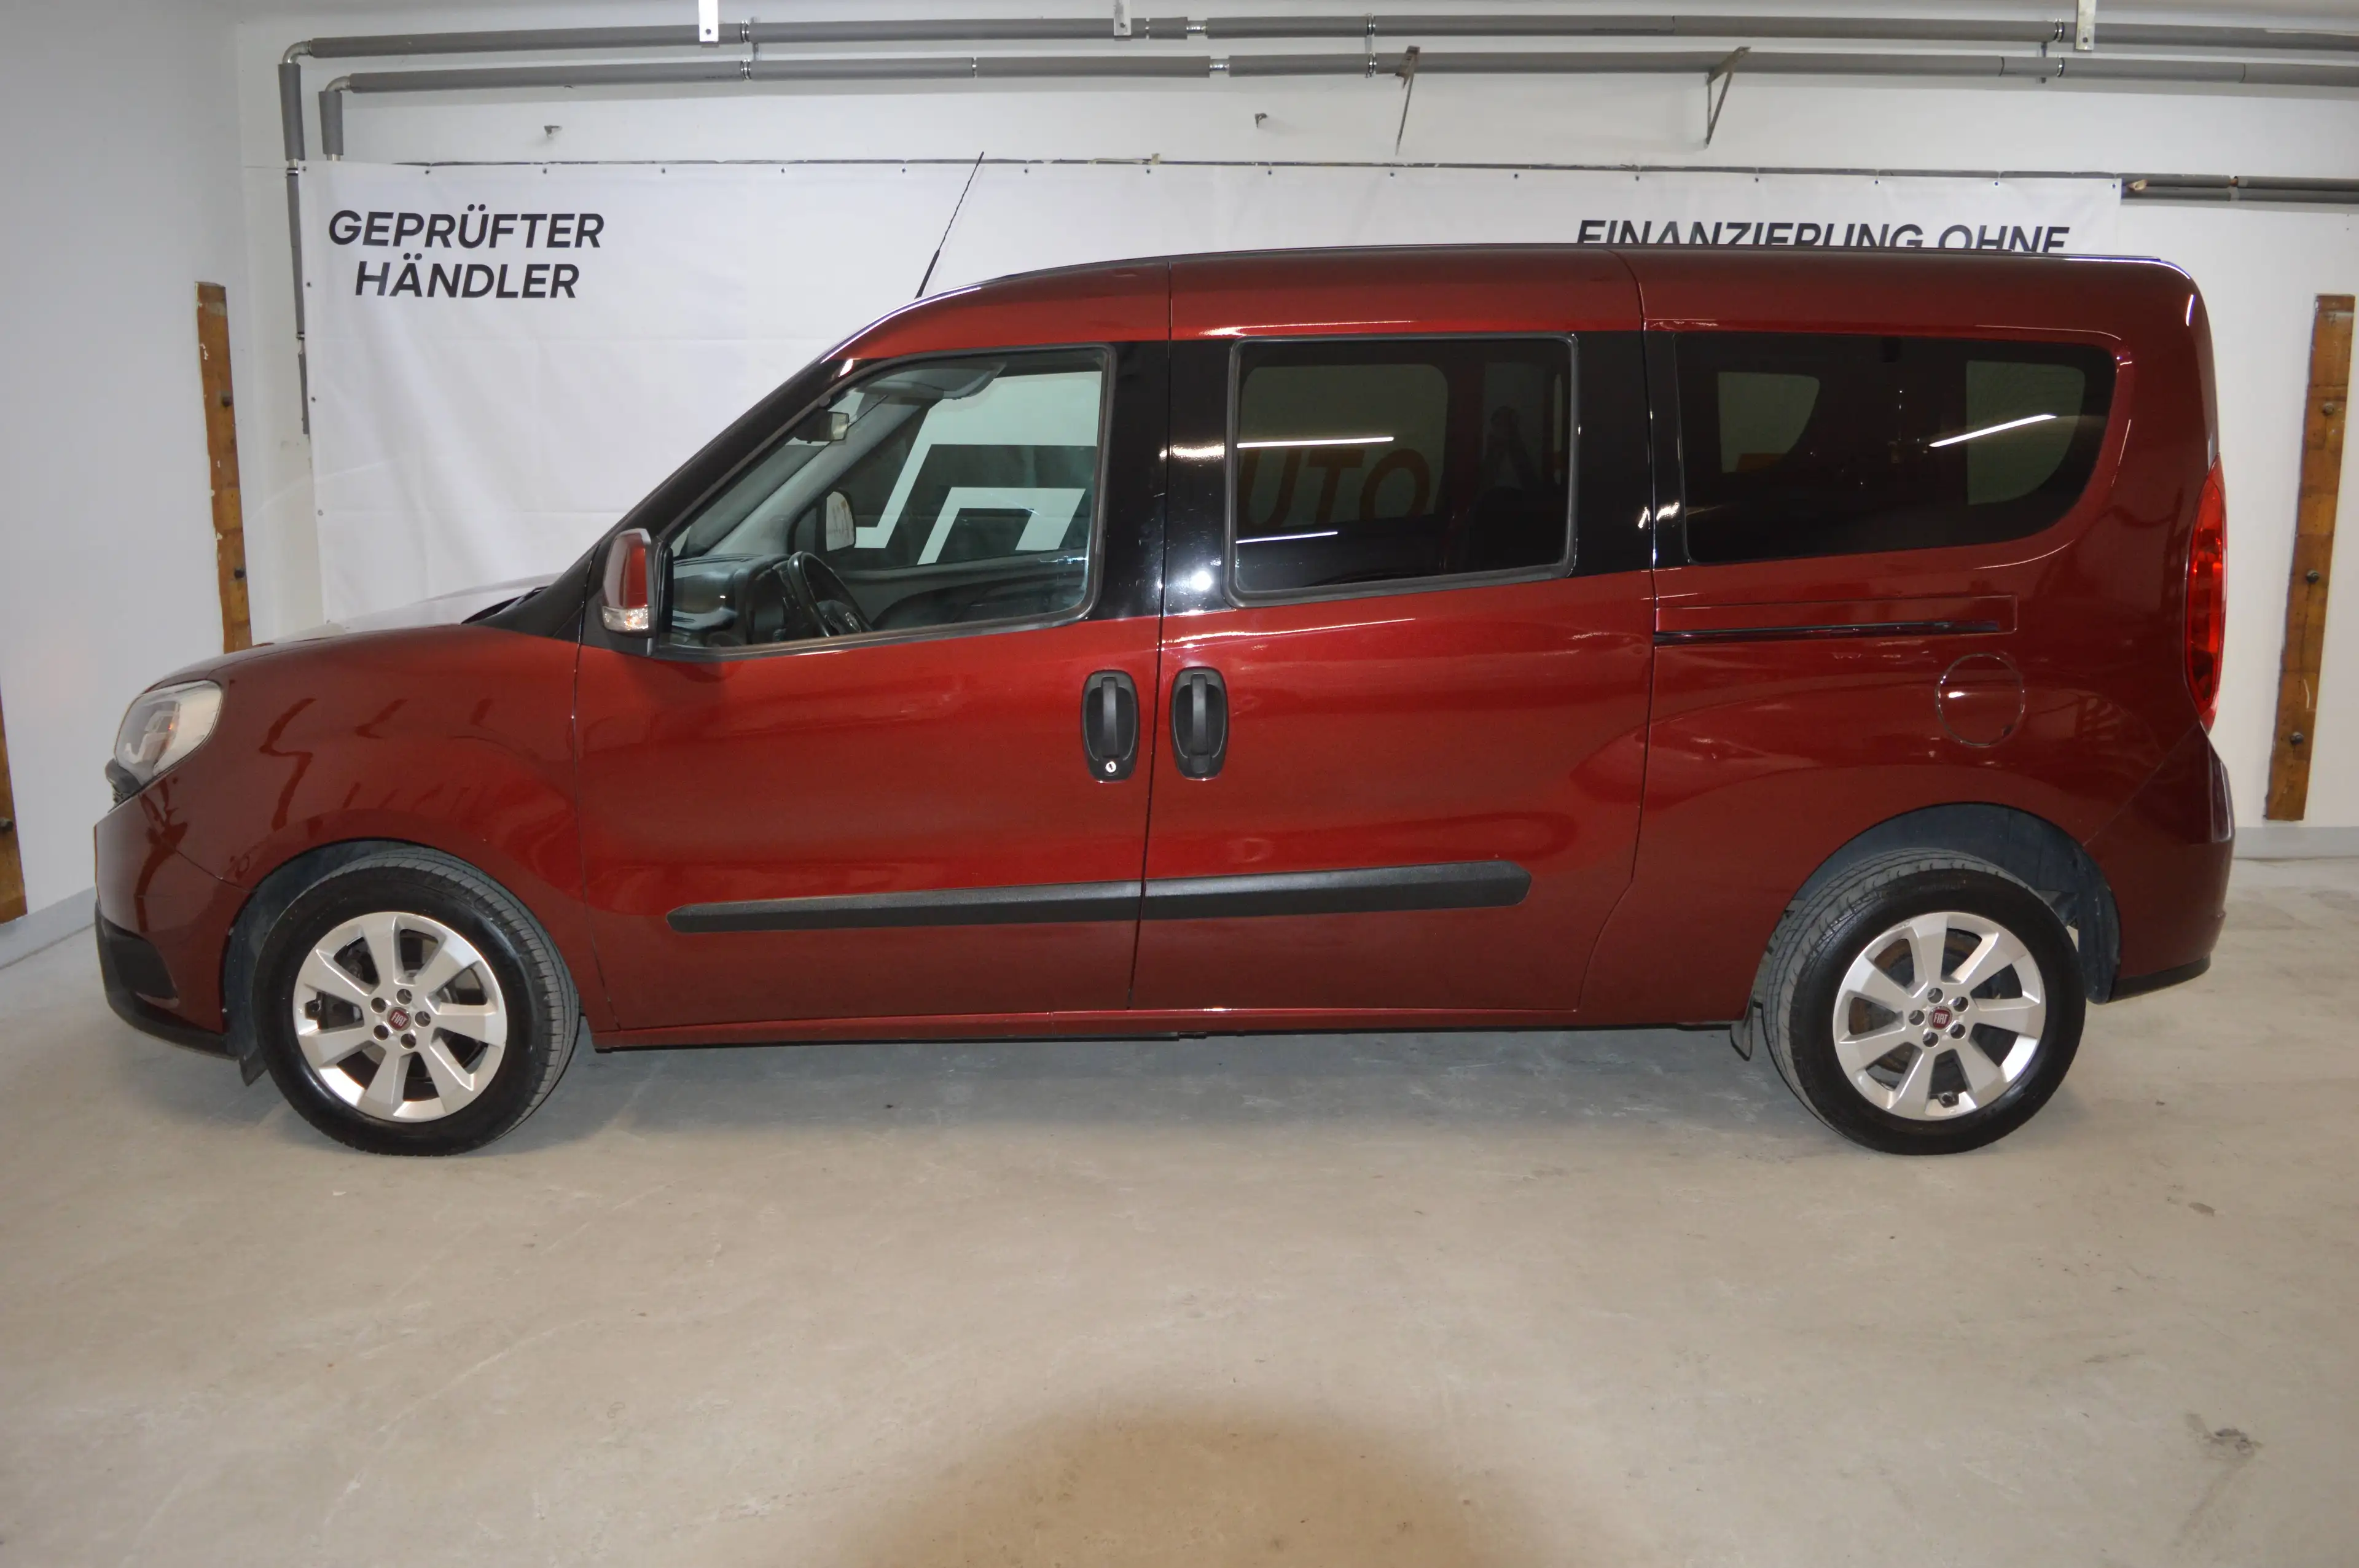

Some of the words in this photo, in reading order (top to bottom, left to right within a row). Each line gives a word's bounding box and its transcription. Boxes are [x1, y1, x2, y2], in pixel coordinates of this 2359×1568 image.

[329, 204, 604, 249] GEPRÜFTER
[355, 253, 579, 298] HÄNDLER
[391, 1012, 407, 1026] FIAT
[1933, 1013, 1947, 1024] FIAT
